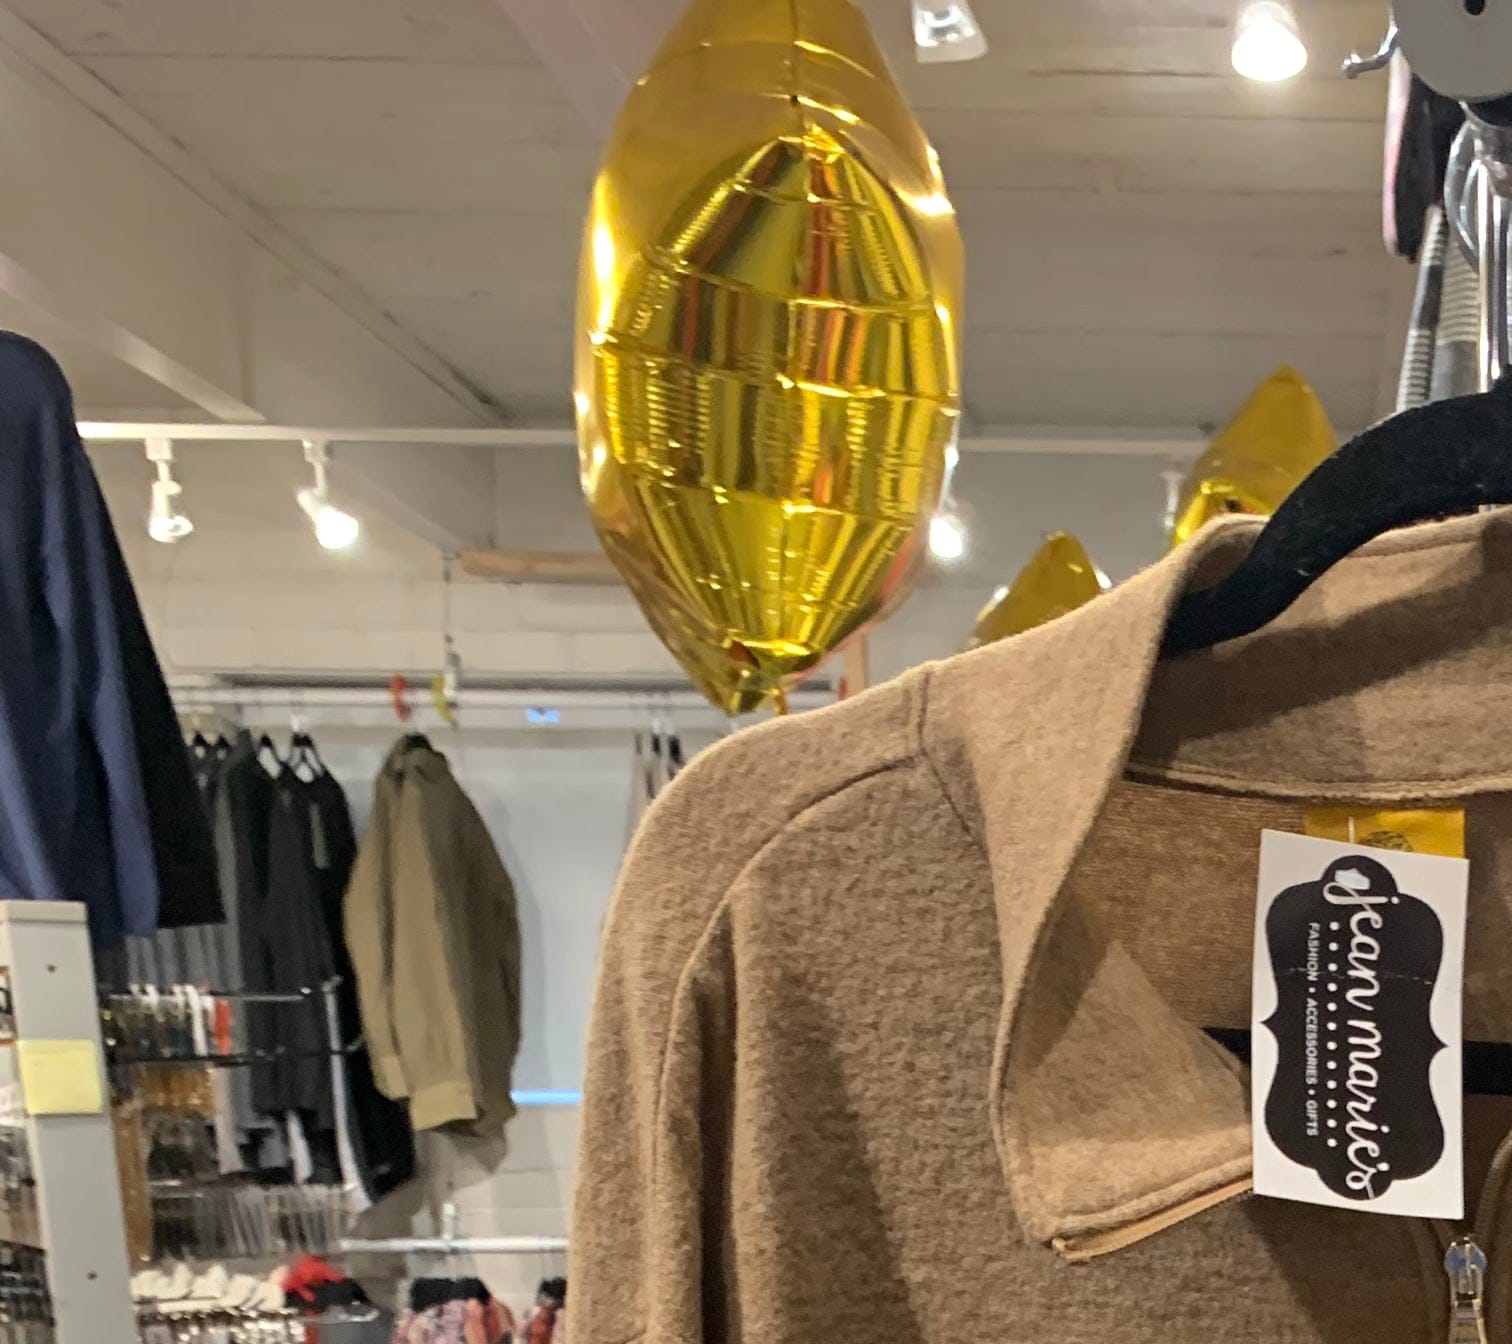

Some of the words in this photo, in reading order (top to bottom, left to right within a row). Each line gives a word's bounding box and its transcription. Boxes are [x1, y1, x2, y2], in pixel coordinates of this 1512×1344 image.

[1306, 922, 1320, 982] FASHION
[1305, 998, 1319, 1085] ACCESSORIES
[1305, 1099, 1319, 1137] GIFTS
